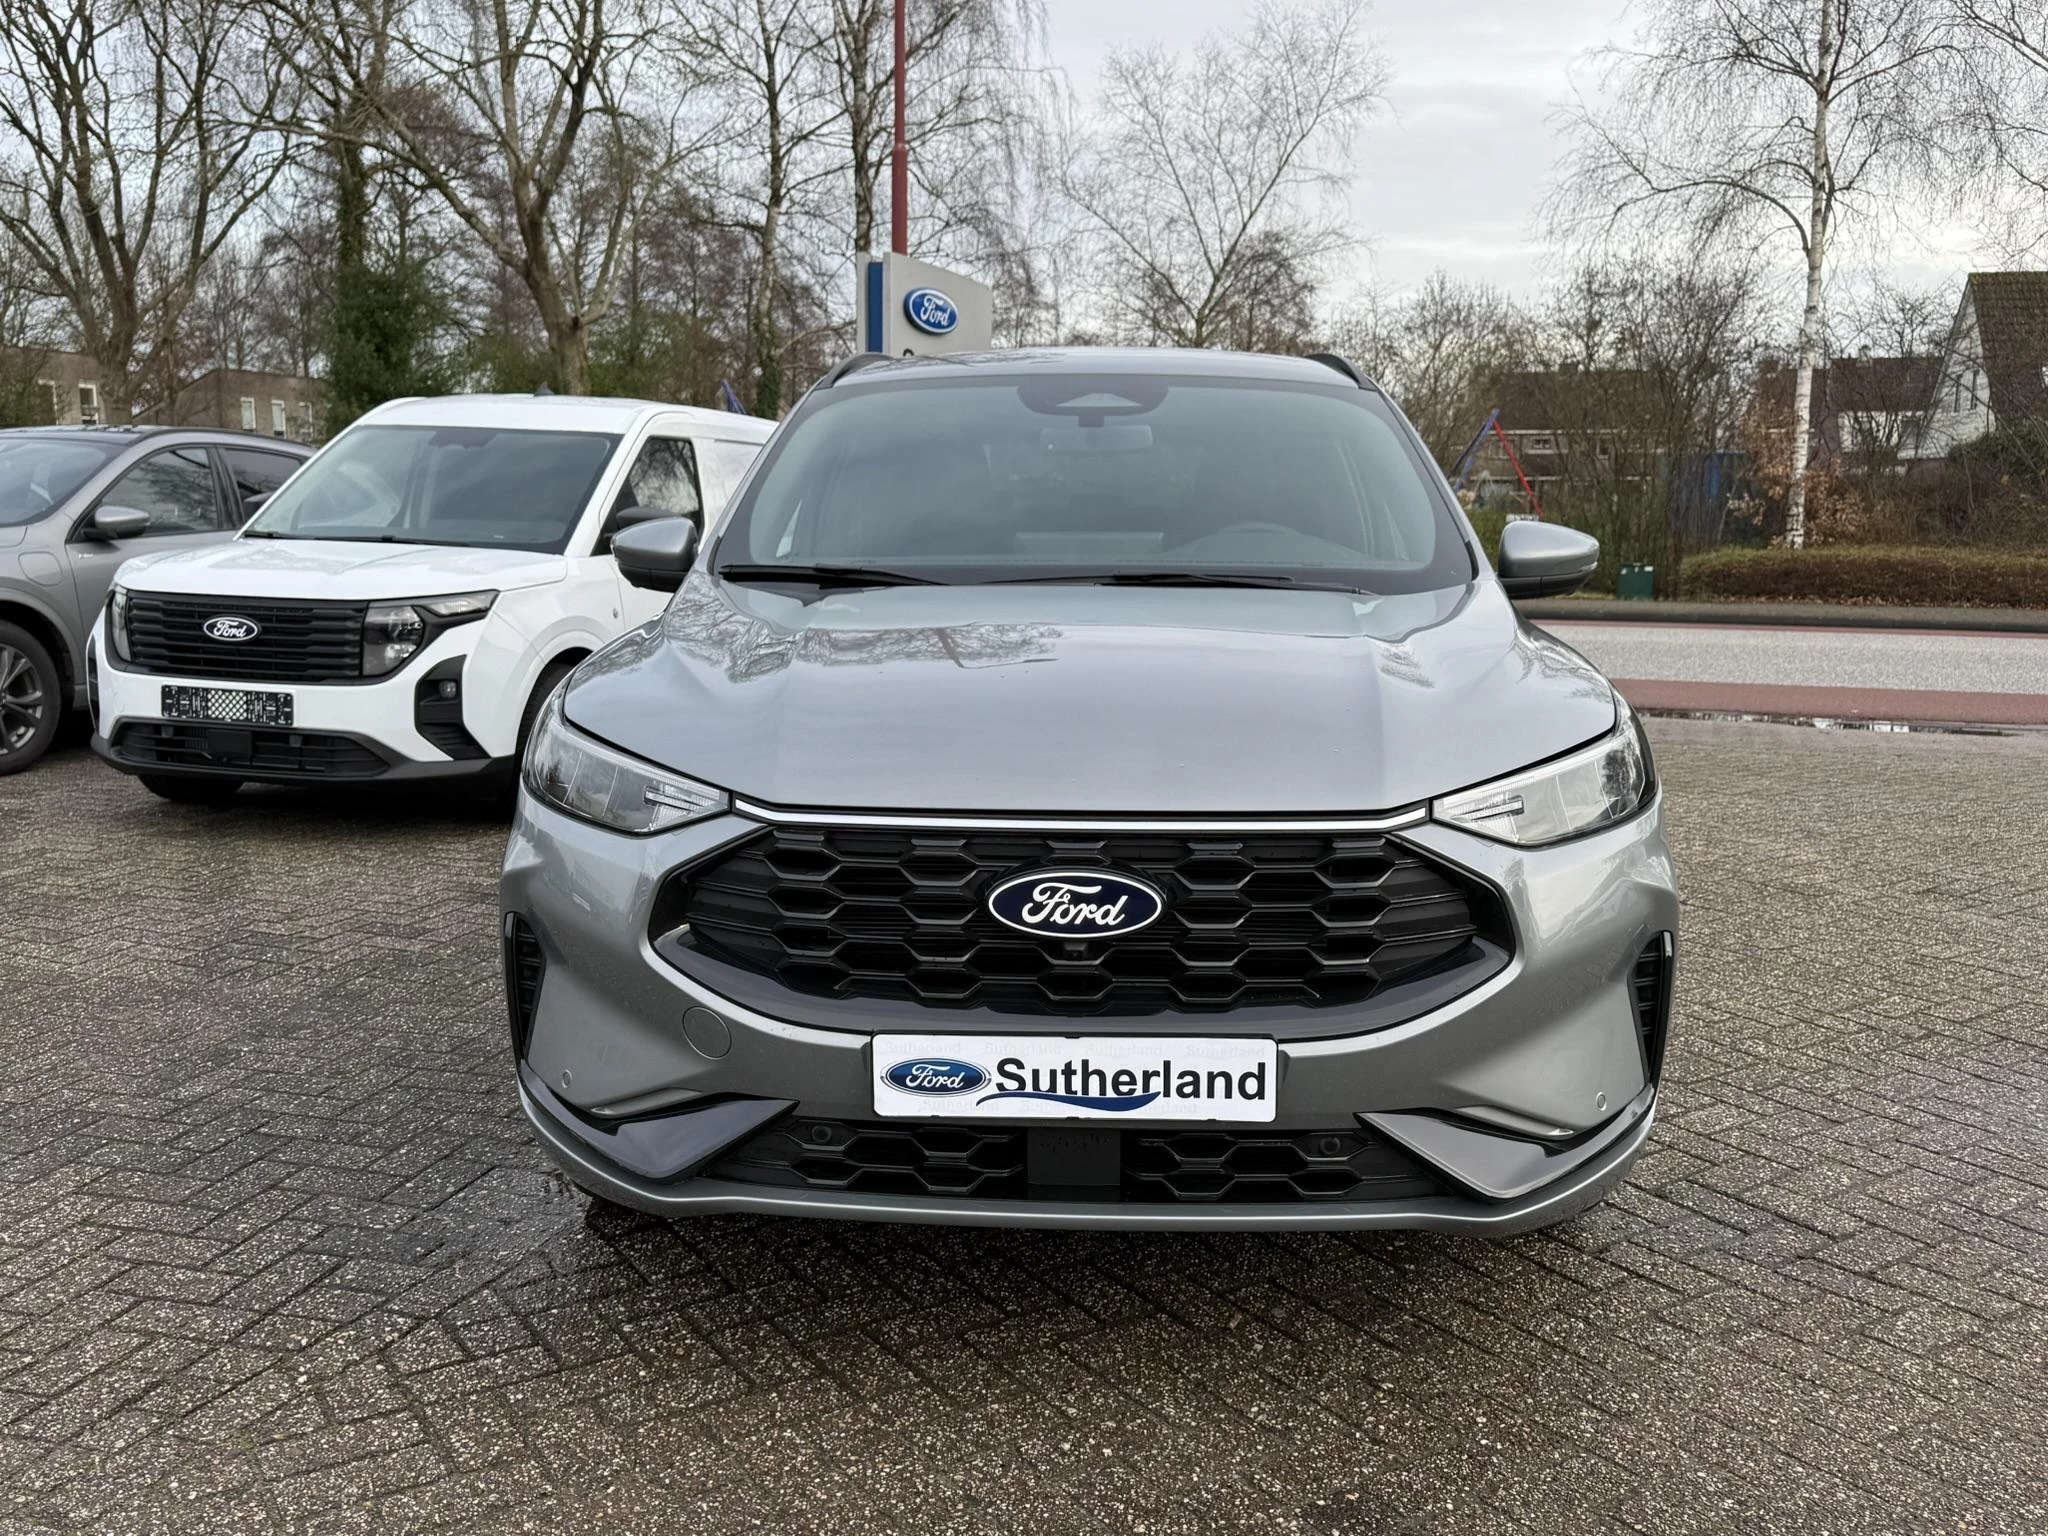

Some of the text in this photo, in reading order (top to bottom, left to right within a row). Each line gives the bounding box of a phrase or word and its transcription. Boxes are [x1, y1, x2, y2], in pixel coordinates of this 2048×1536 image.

[920, 295, 951, 327] Ford
[214, 621, 247, 637] Ford
[1021, 882, 1129, 926] Ford
[905, 1057, 1266, 1101] Ford Sutherland
